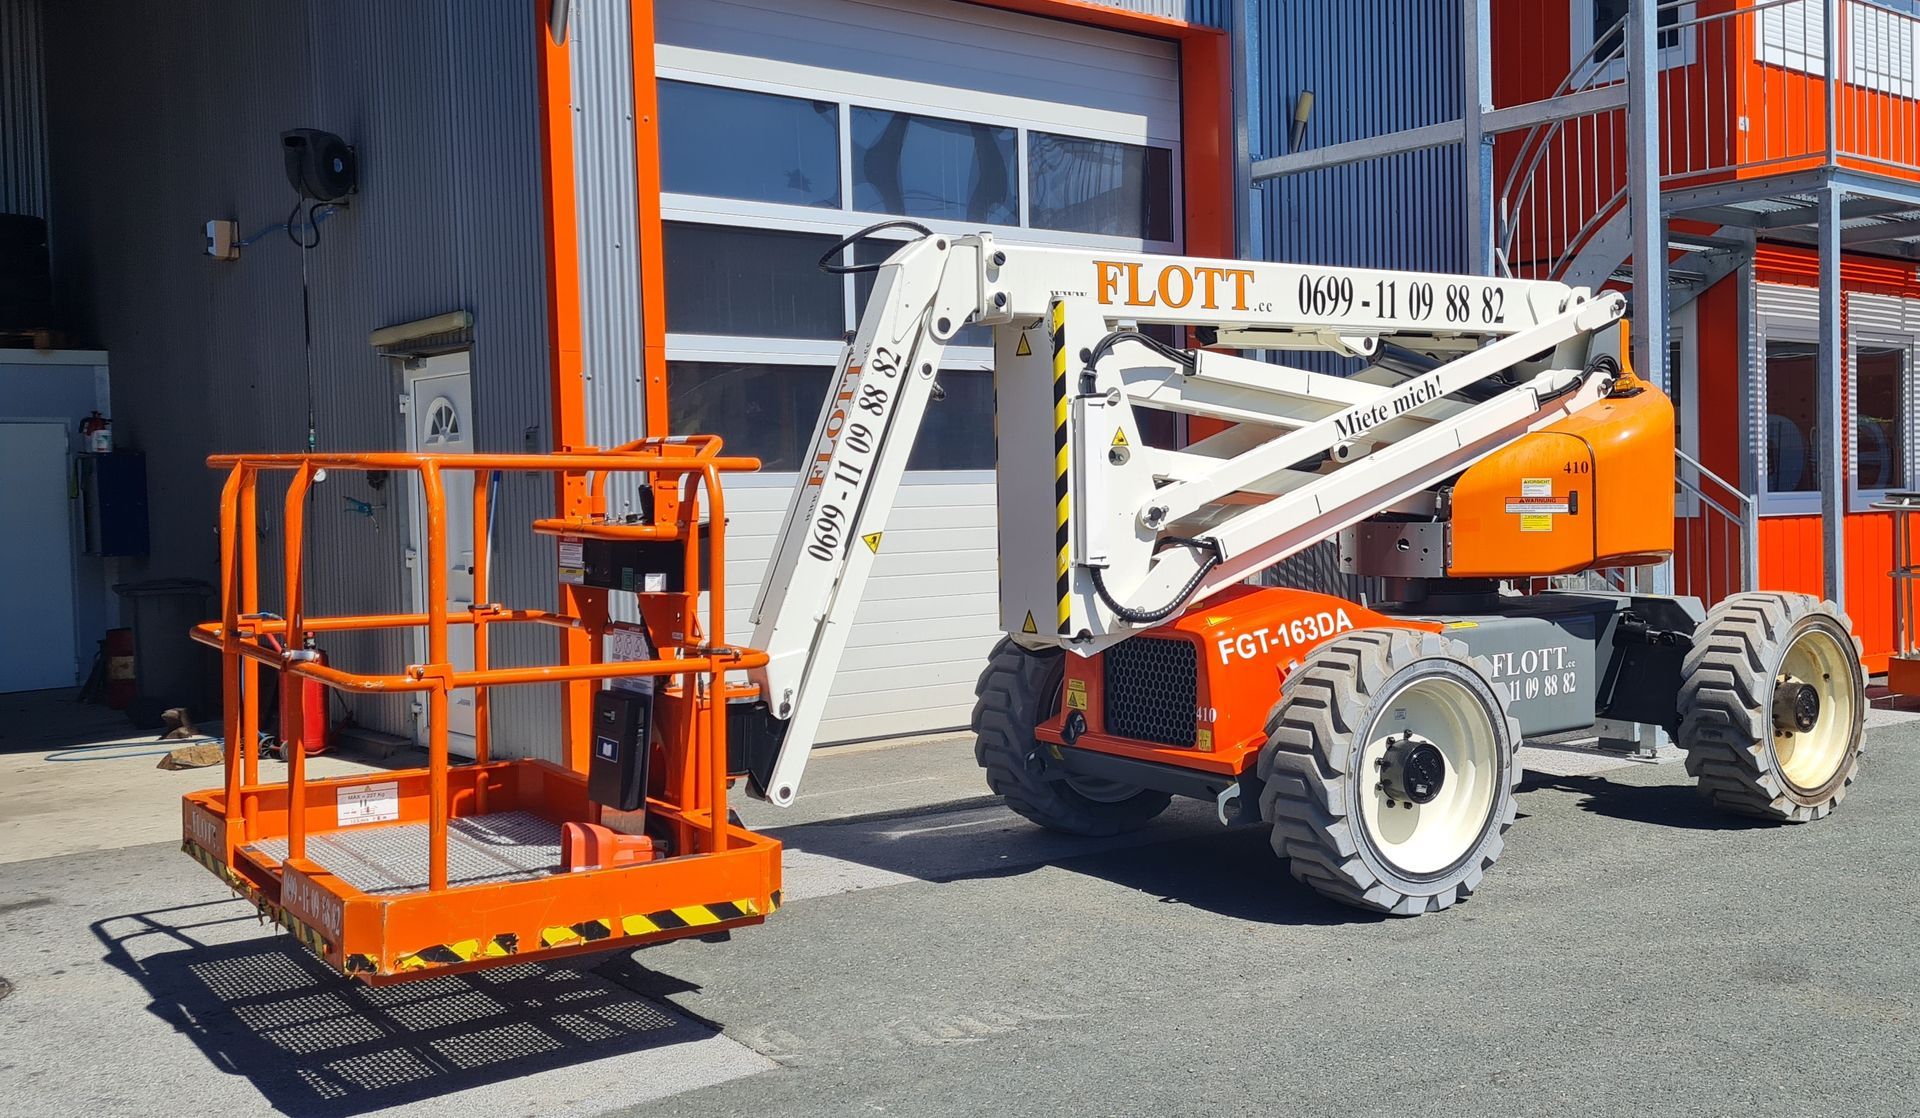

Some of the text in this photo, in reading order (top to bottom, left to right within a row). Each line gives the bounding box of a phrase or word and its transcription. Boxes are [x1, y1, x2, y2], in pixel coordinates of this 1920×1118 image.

[1298, 273, 1354, 317] 0699
[1376, 279, 1398, 319] 11
[1408, 281, 1434, 321] 09
[1446, 283, 1470, 323] 88
[1482, 286, 1505, 324] 82
[871, 346, 902, 379] 82
[858, 383, 889, 416] 88
[1334, 374, 1443, 441] Miete mich!
[845, 422, 874, 454] 09
[834, 460, 864, 490] 11
[1563, 461, 1589, 474] 410
[807, 504, 846, 562] 0699
[1217, 608, 1354, 665] FGT-163DA
[1509, 679, 1521, 702] 11
[1525, 677, 1539, 699] 09
[1544, 674, 1558, 696] 88
[1562, 672, 1576, 694] 82
[1196, 705, 1217, 723] 410
[302, 883, 309, 914] 11
[311, 888, 320, 920] 09
